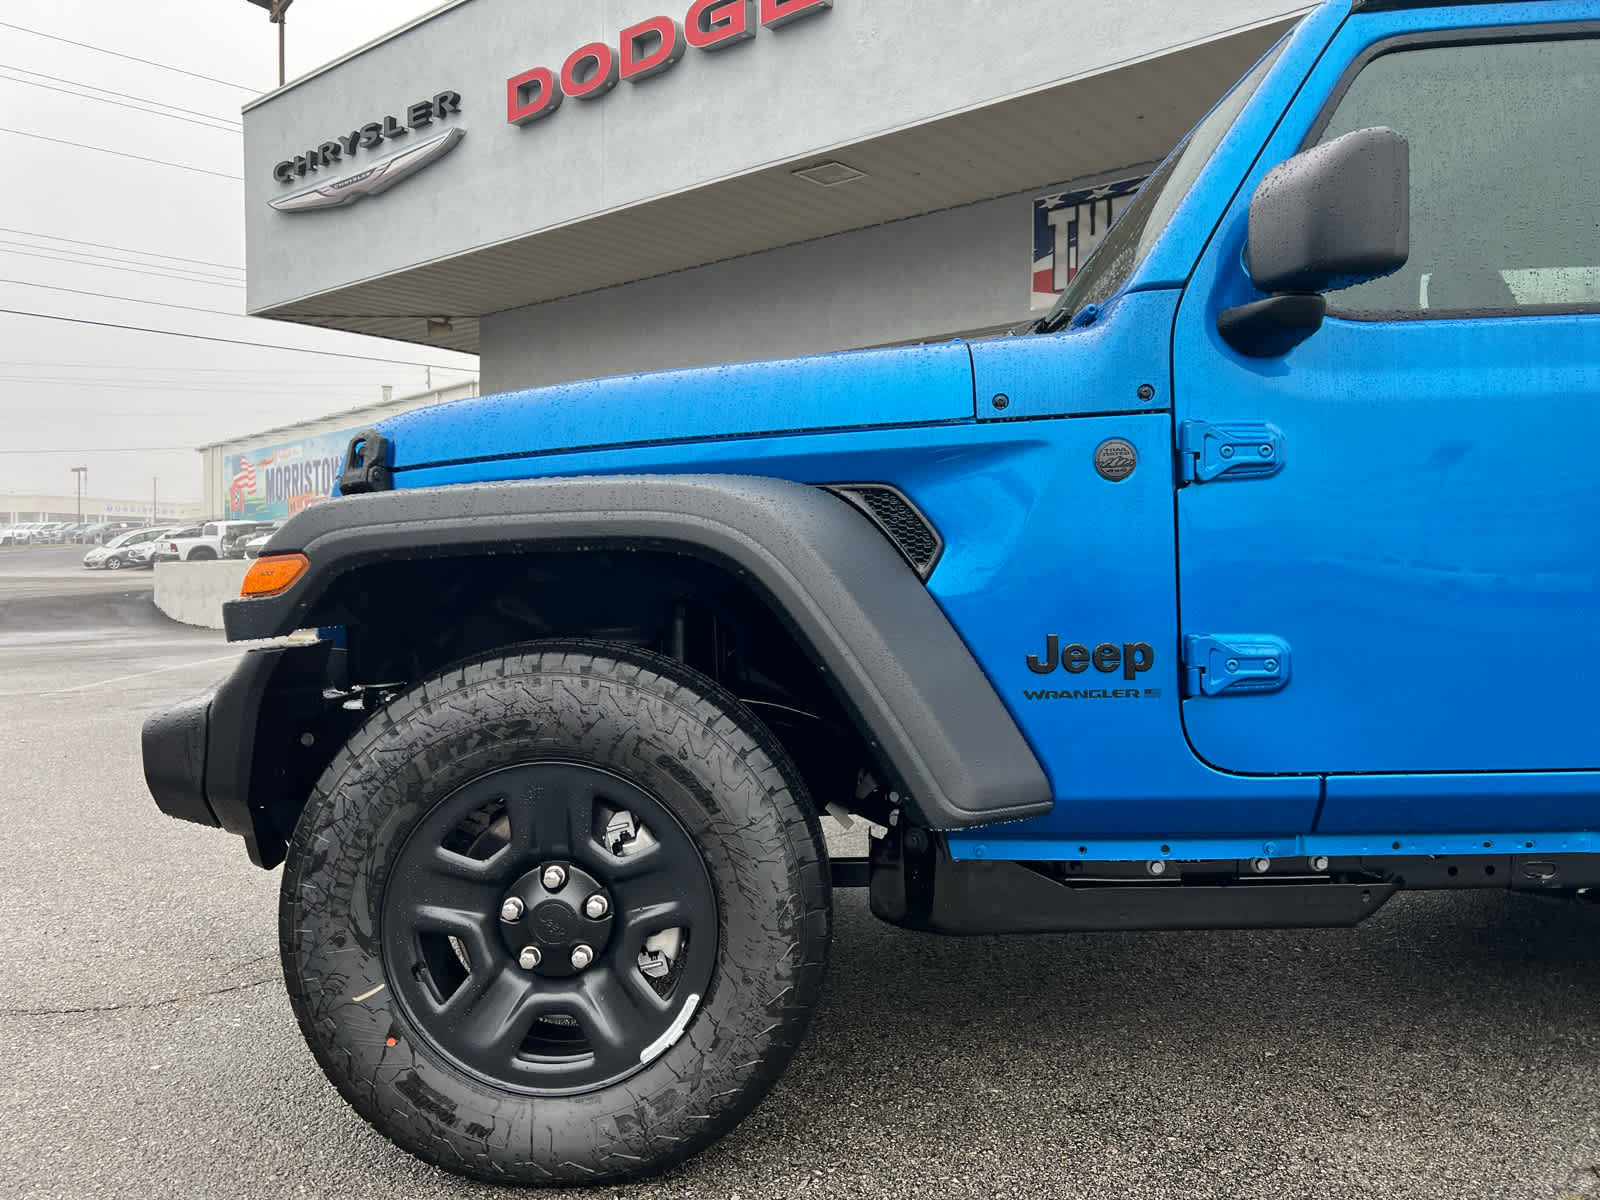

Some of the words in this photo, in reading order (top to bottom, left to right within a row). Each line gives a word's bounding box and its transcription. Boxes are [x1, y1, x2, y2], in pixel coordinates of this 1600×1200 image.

[273, 90, 462, 184] CHRYSLER
[1026, 633, 1154, 680] Jeep
[1024, 688, 1140, 700] WRANGLER
